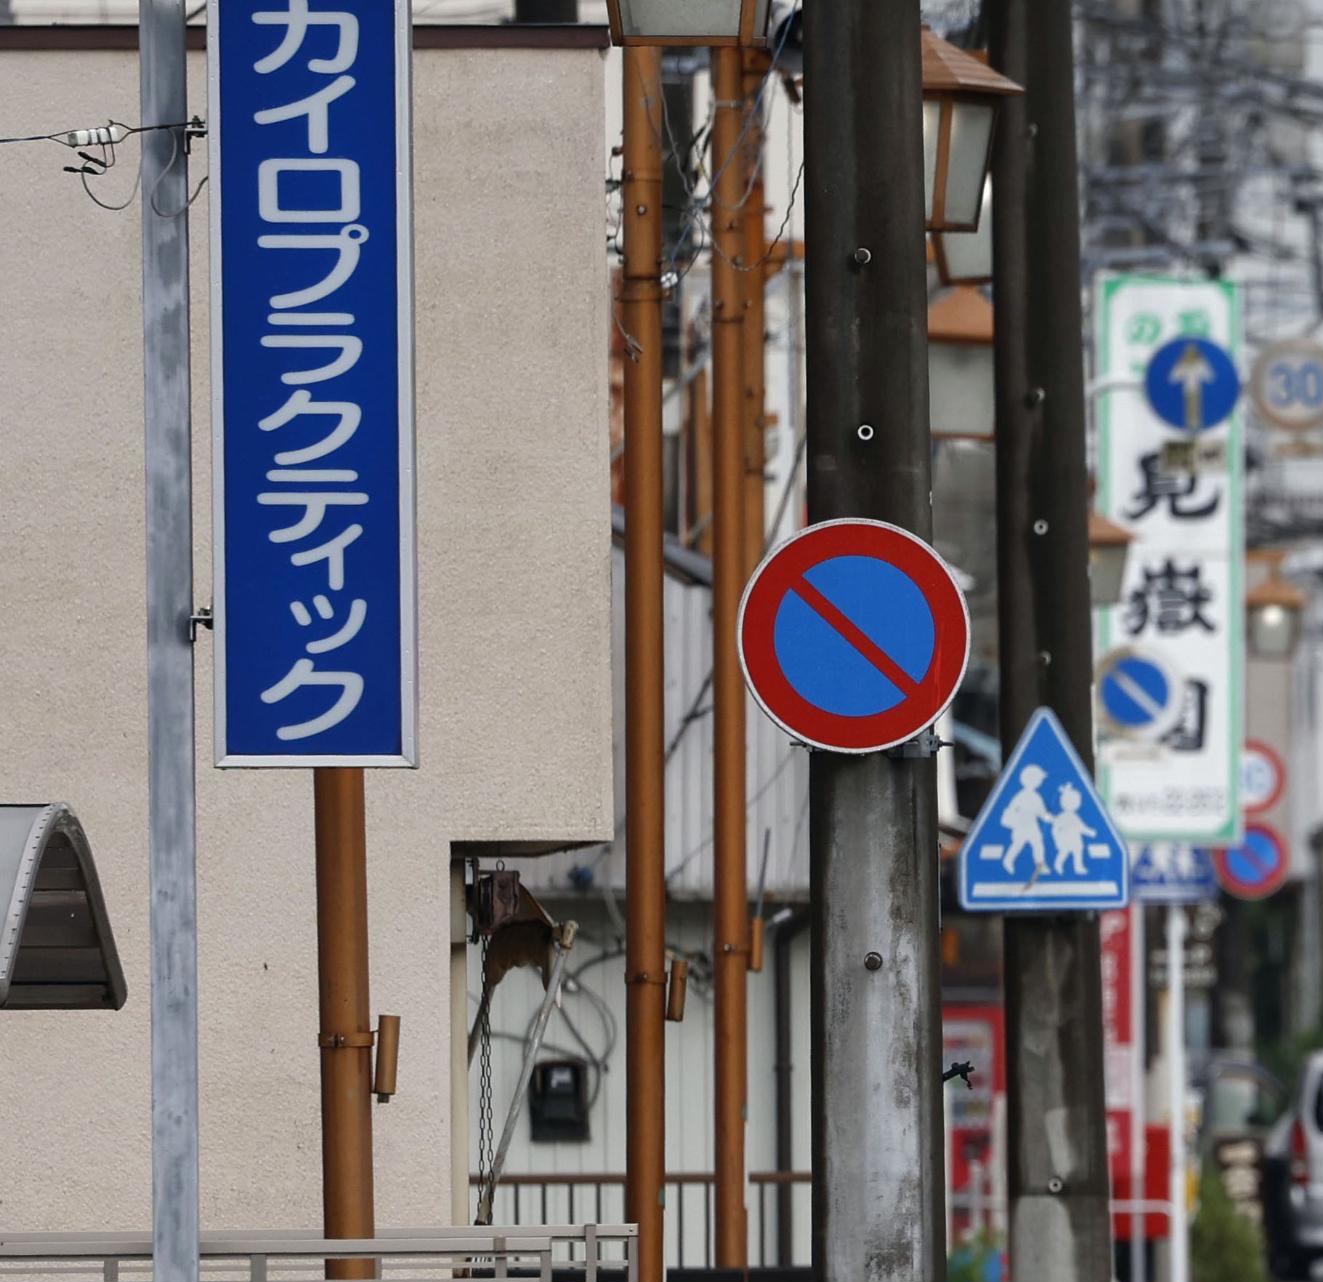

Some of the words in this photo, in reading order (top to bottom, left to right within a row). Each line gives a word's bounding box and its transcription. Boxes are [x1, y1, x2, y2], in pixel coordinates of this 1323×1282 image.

[253, 0, 370, 742] カイロプラクティック
